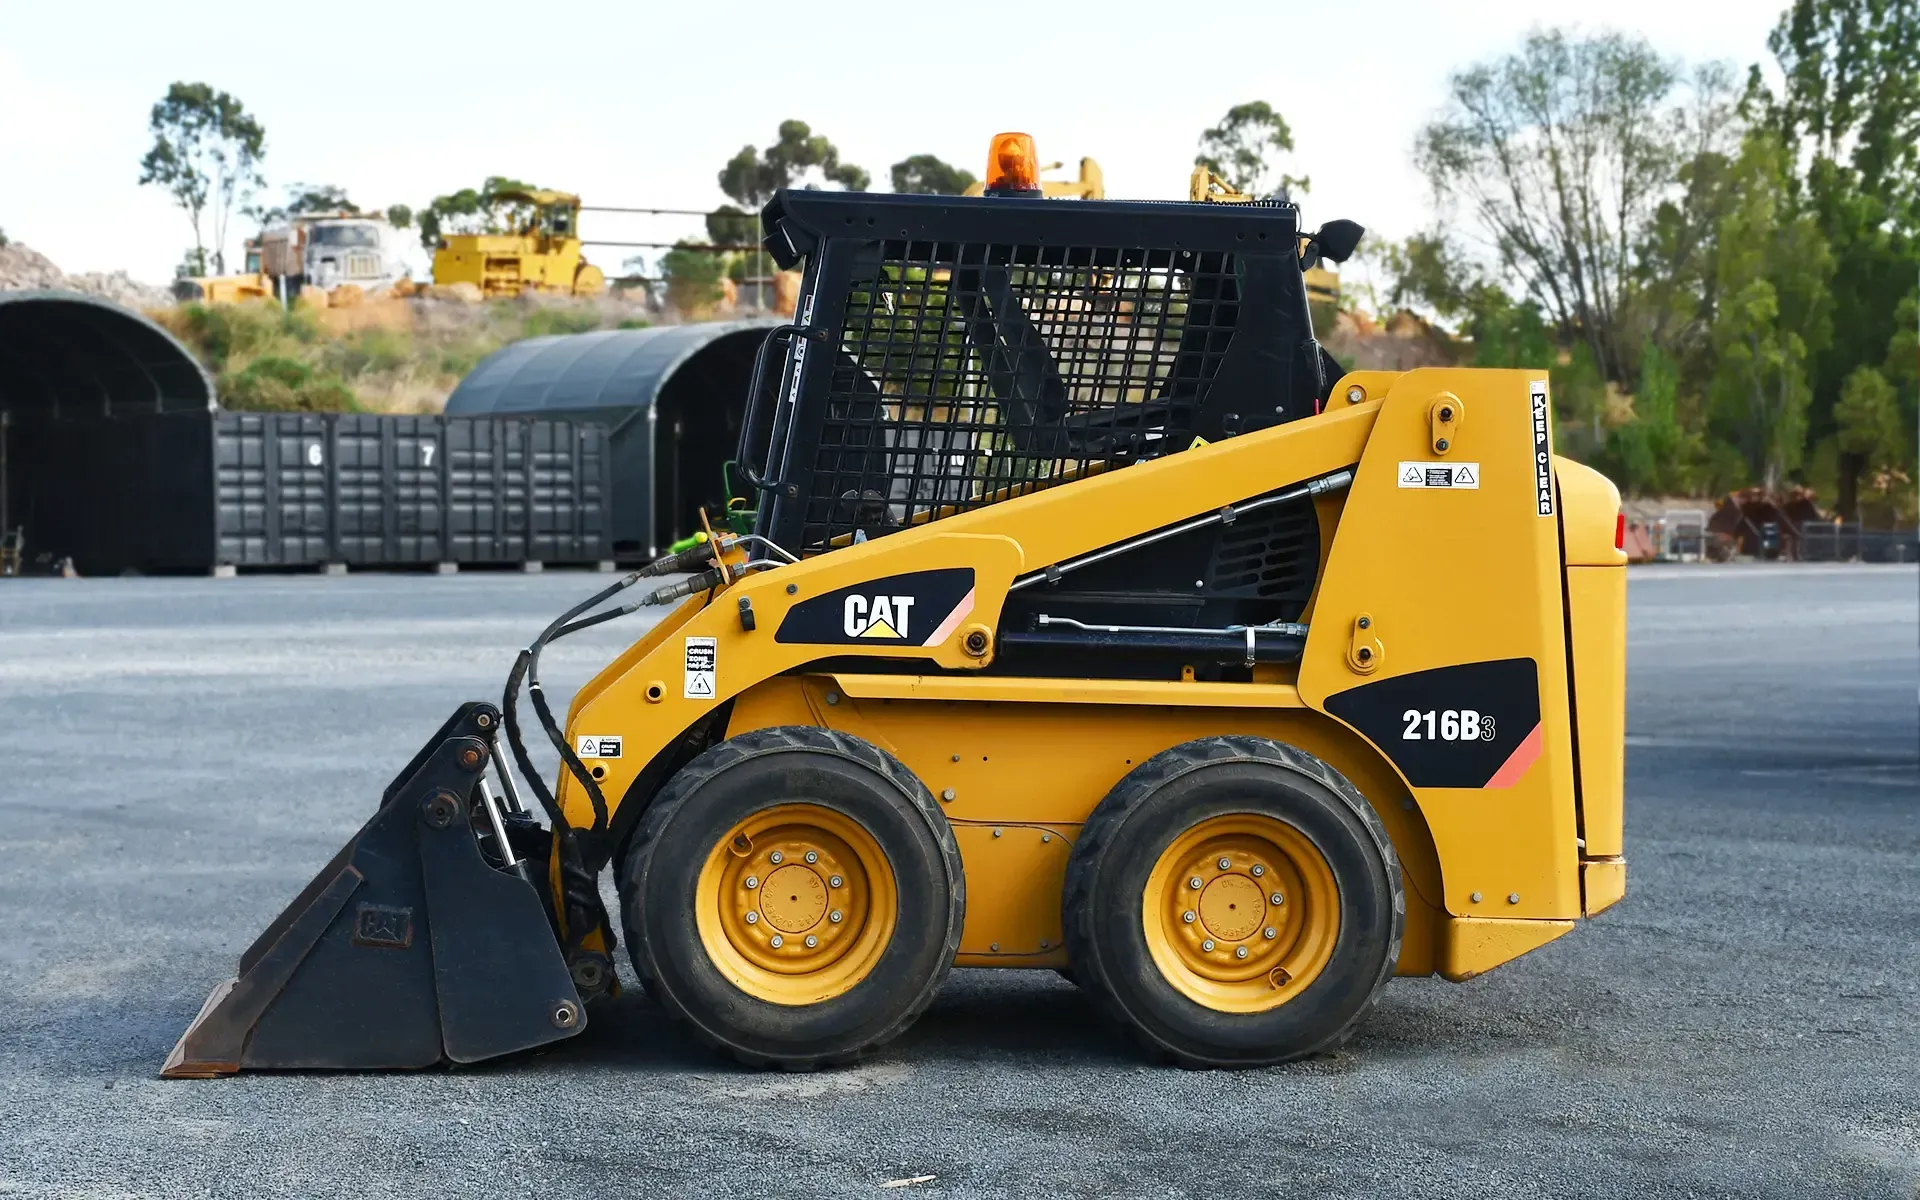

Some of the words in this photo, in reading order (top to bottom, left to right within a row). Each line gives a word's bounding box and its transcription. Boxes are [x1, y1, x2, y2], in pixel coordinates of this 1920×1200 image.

[1533, 395, 1546, 444] KEEP
[309, 444, 322, 466] 6
[422, 446, 435, 466] 7
[1537, 451, 1551, 514] CLEAR
[844, 594, 915, 638] CAT
